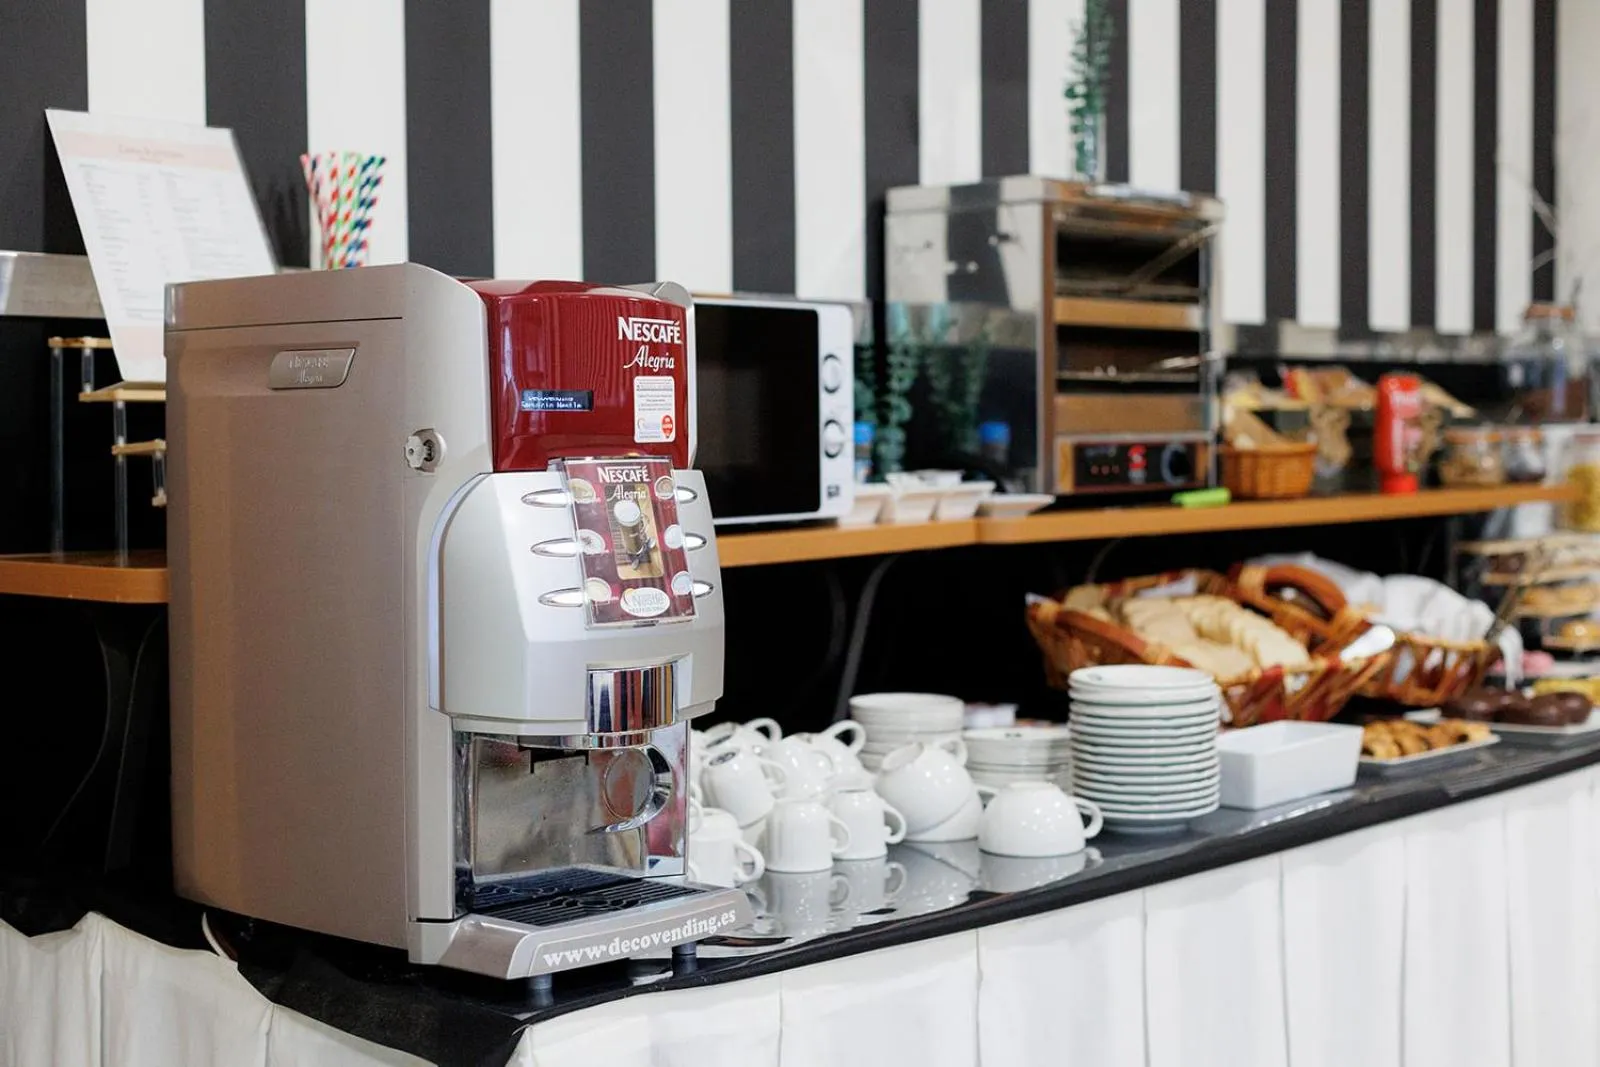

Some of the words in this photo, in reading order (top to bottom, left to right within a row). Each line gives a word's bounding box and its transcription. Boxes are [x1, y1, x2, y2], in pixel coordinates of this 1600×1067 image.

[617, 316, 682, 344] NESCAFÉ
[623, 345, 675, 372] Alegria
[597, 465, 651, 483] NESCAFÉ
[605, 484, 647, 501] Alegria
[542, 908, 737, 968] www.decovending.es
